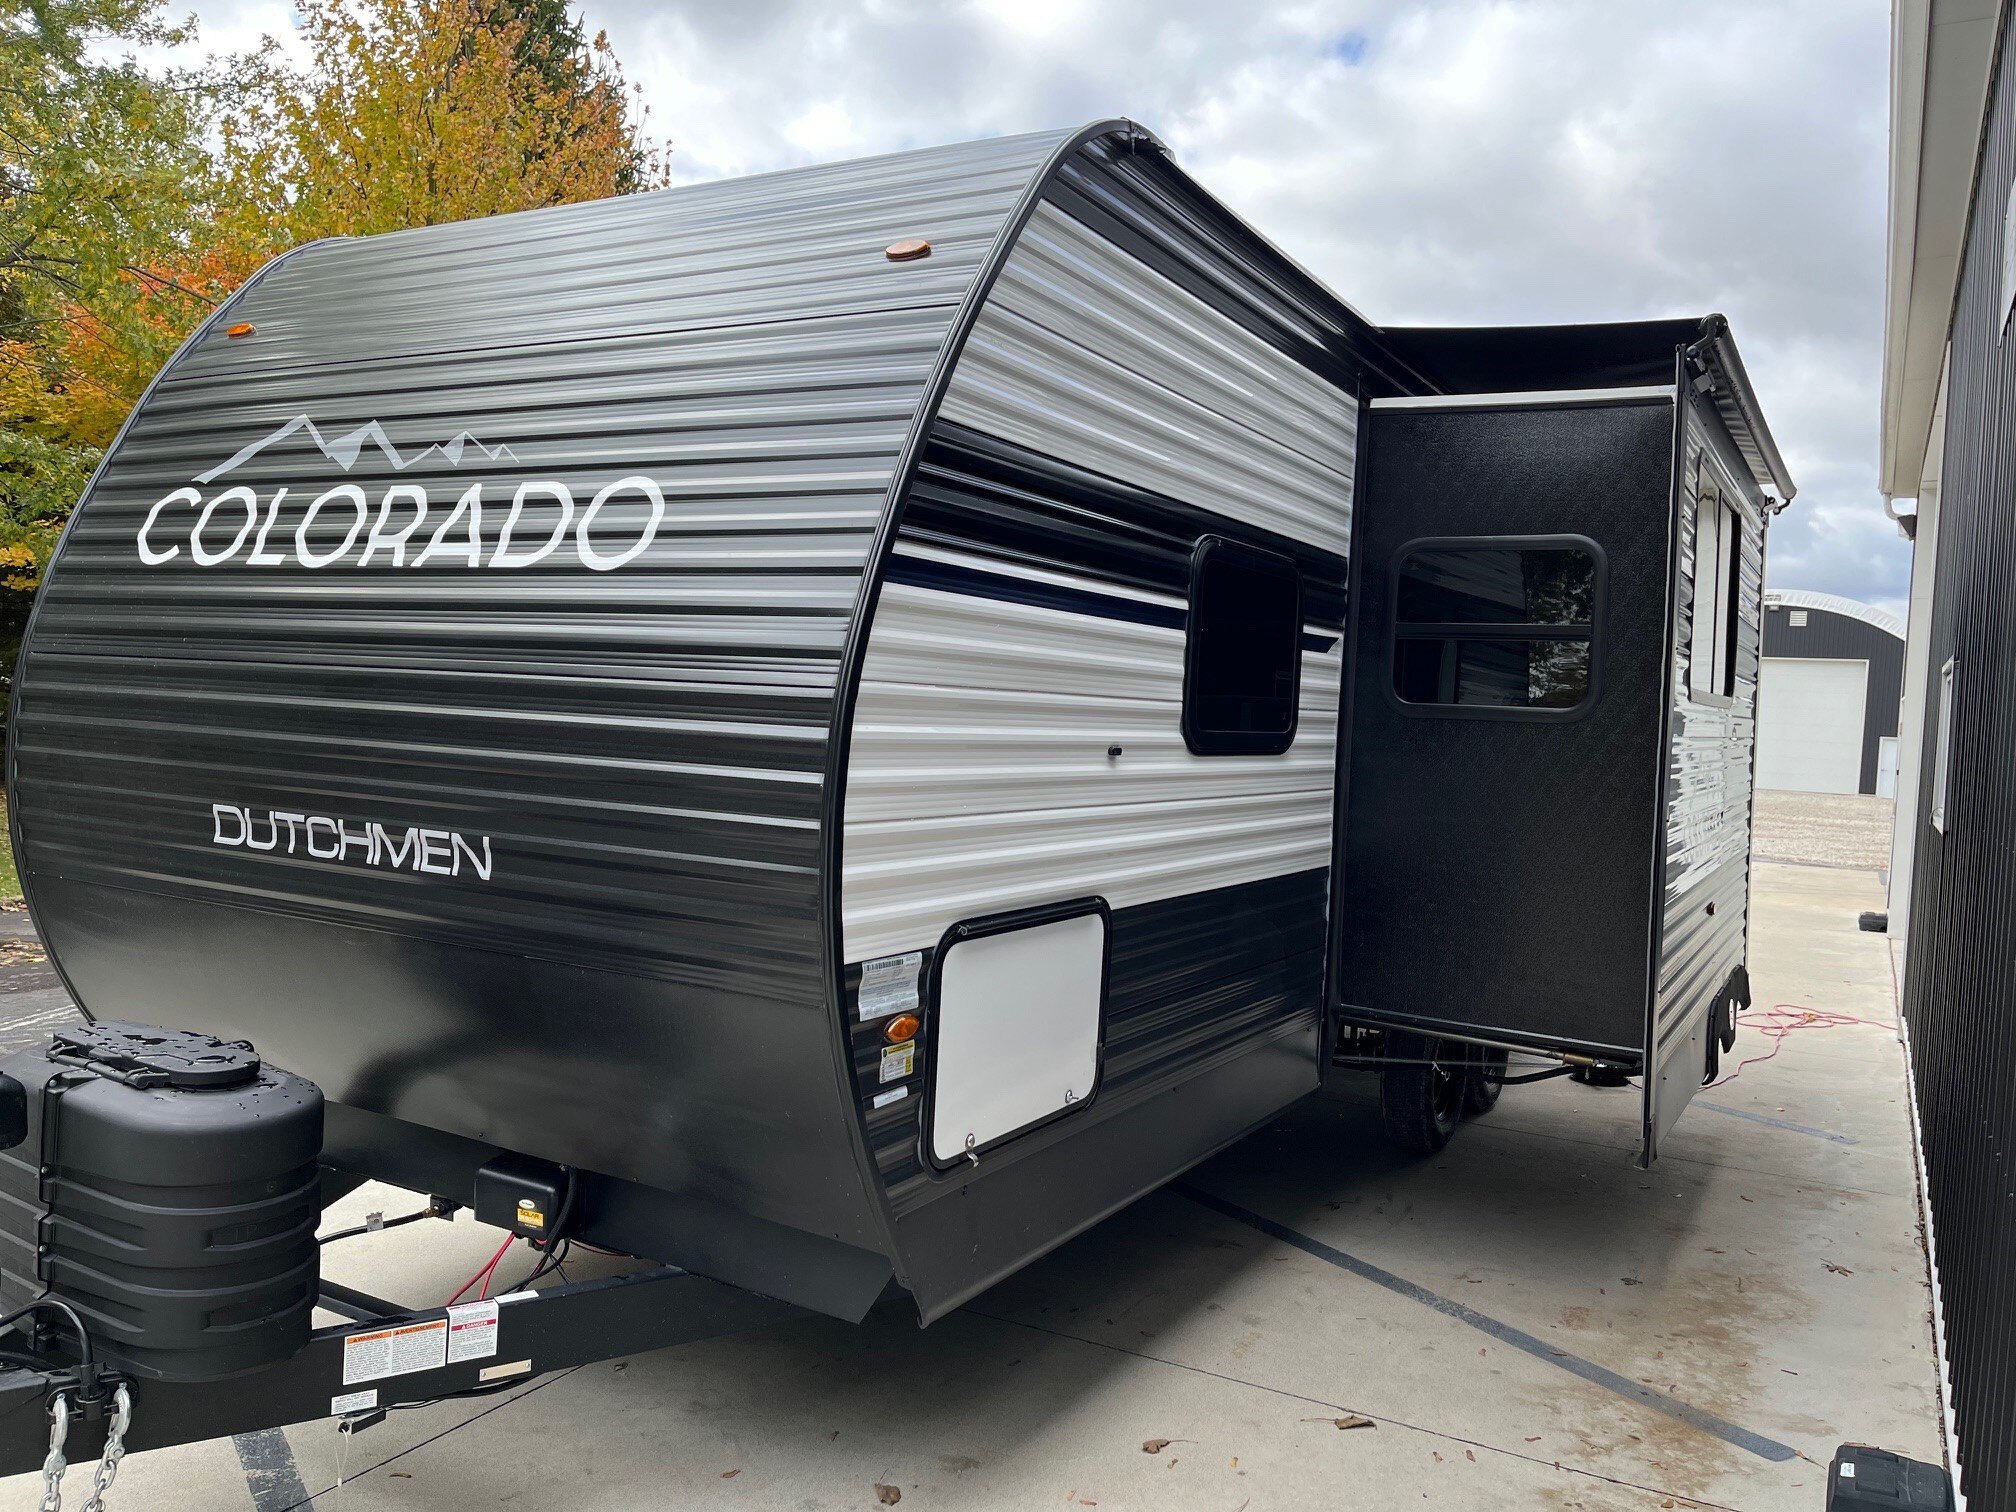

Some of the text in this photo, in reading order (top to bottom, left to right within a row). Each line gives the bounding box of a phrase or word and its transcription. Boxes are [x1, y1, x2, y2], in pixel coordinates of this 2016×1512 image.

[137, 476, 665, 571] COLORADO
[212, 804, 491, 881] DUTCHMEN
[518, 1208, 540, 1219] SOLAR
[465, 1320, 487, 1329] DANGER
[358, 1333, 383, 1342] WARNING
